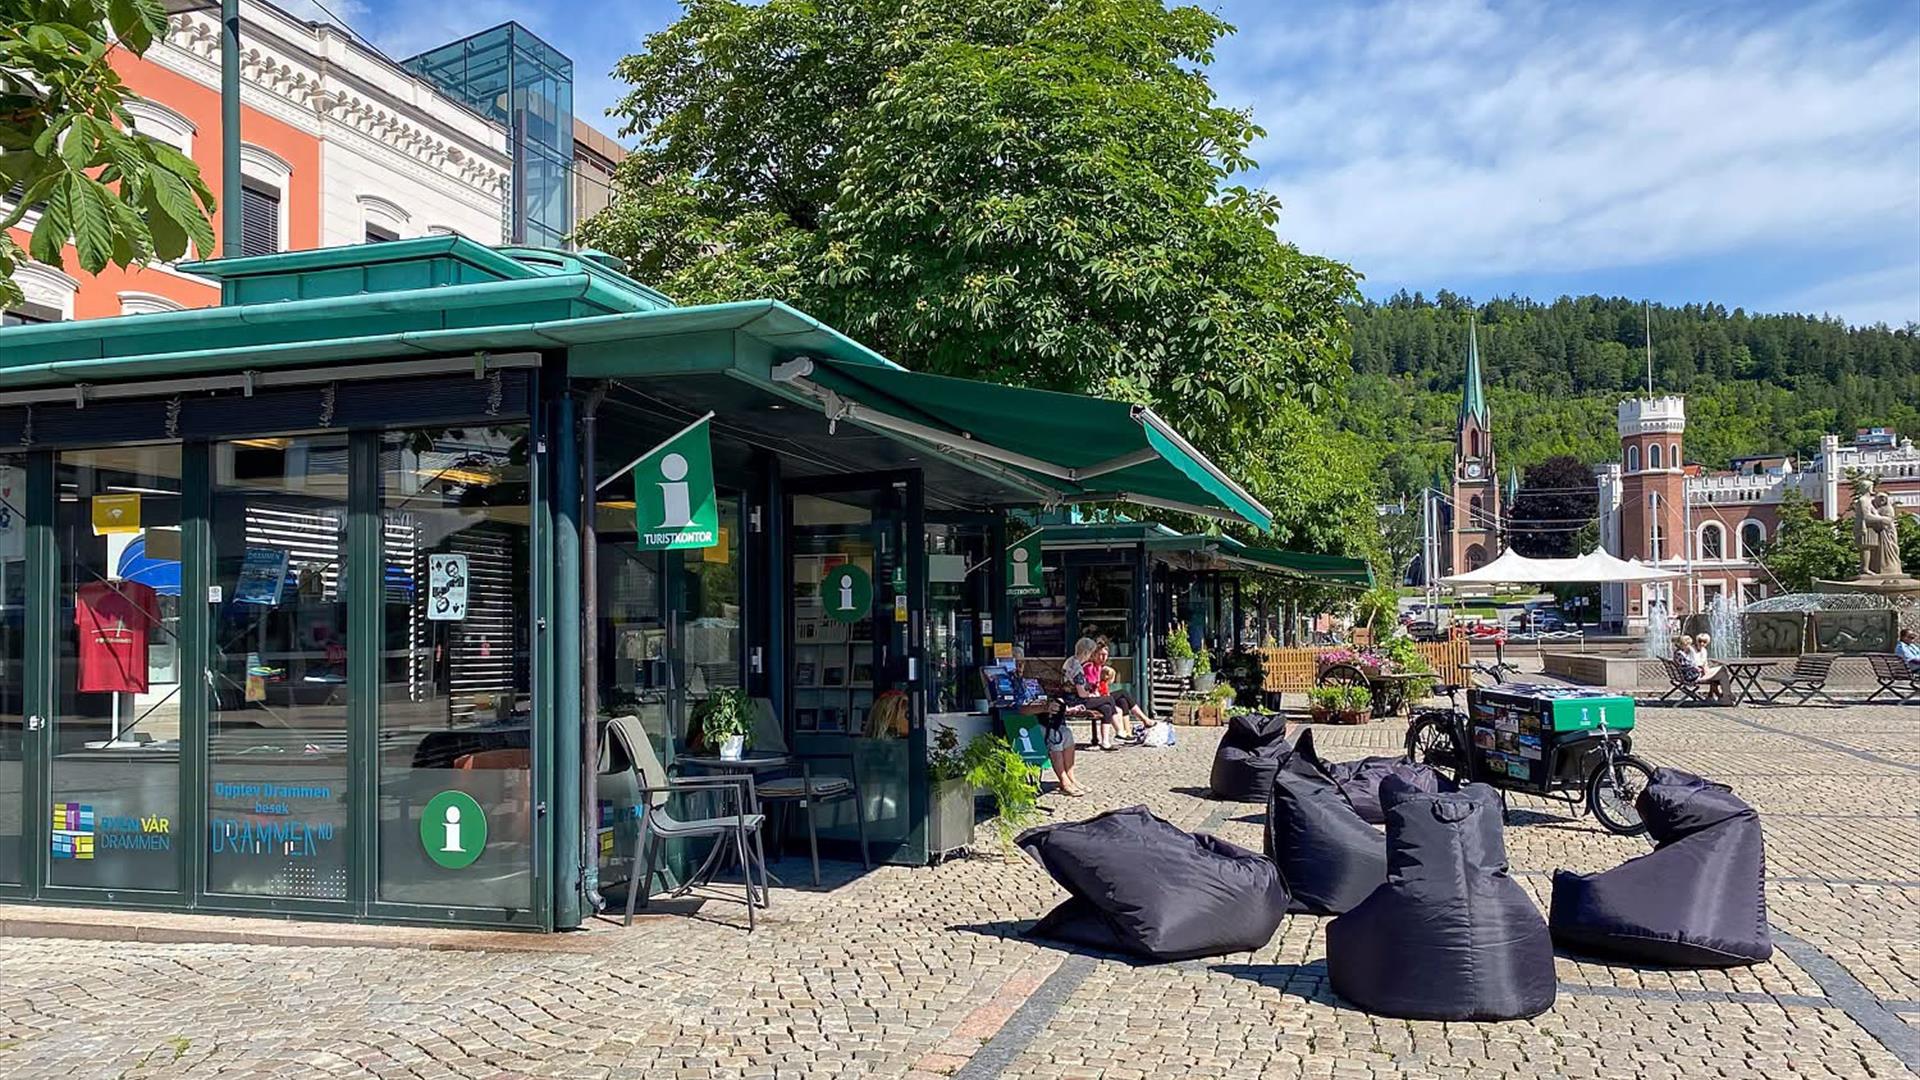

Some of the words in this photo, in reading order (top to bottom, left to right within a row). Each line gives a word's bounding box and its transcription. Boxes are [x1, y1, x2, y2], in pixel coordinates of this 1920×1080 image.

[643, 531, 713, 545] TURISTKONTOR
[264, 783, 330, 799] Drammen
[141, 813, 169, 833] VÅR
[101, 834, 171, 850] DRAMMEN
